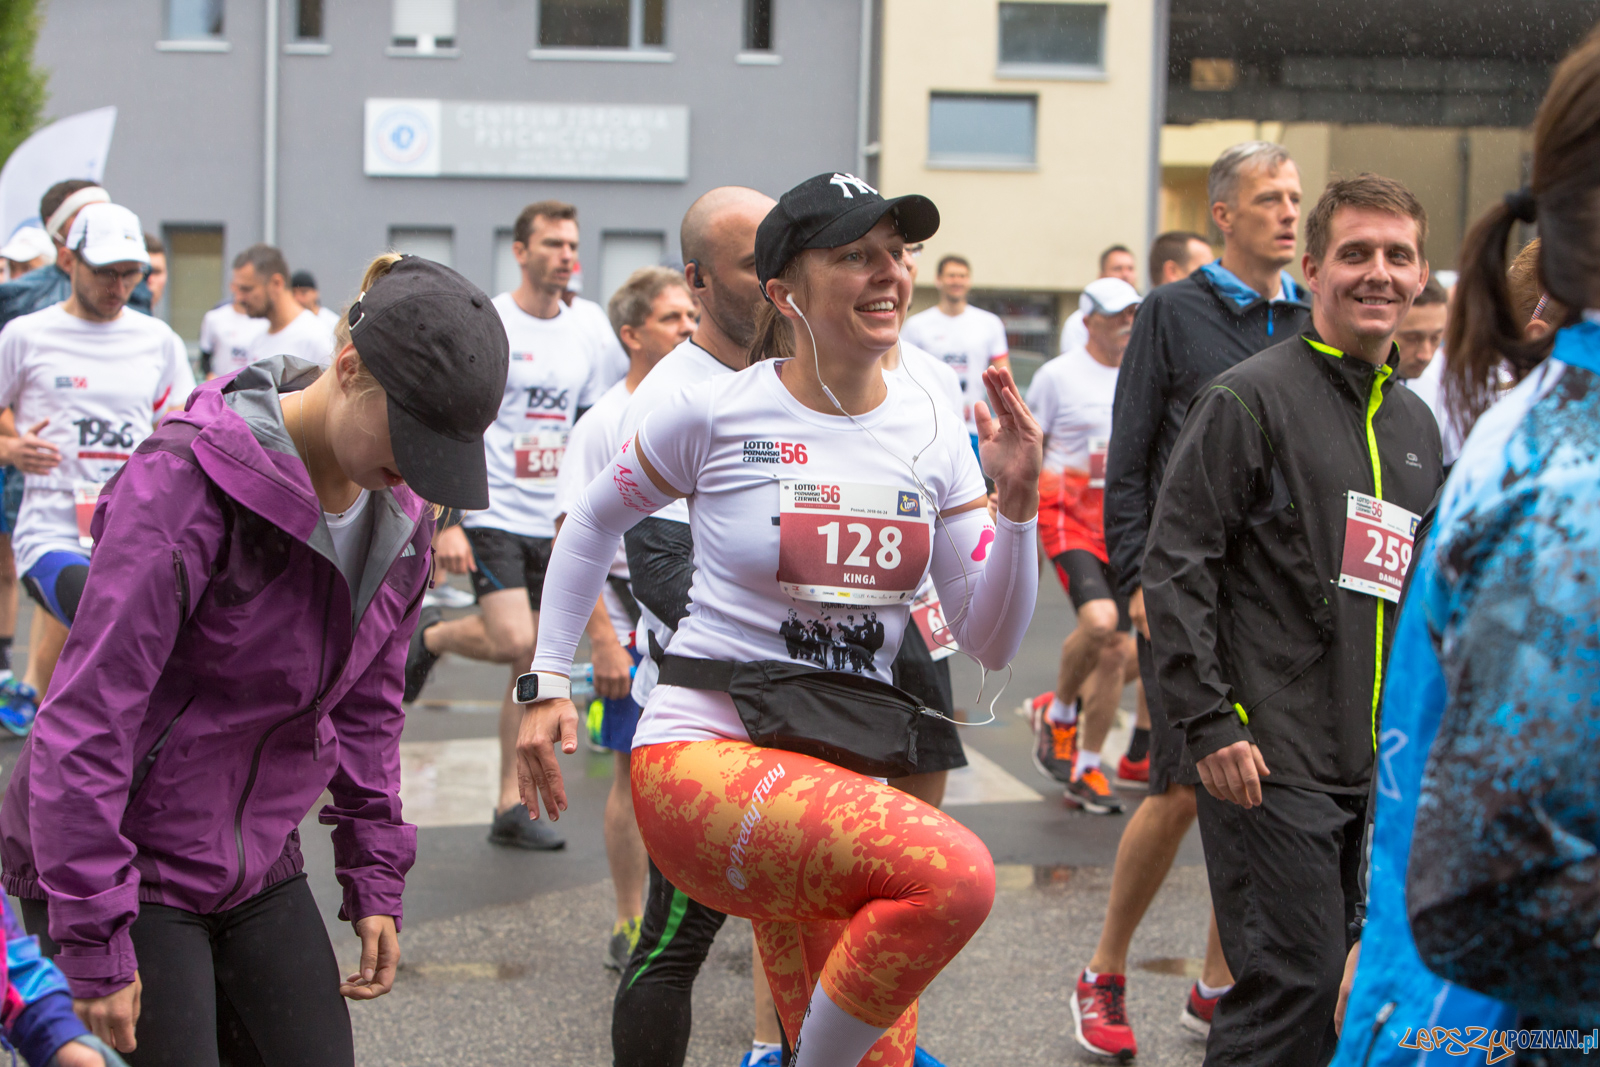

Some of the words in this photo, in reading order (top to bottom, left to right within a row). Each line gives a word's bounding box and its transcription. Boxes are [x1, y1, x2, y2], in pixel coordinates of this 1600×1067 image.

[743, 441, 774, 450] LOTTO
[742, 456, 780, 464] CZERWIEC
[817, 521, 903, 570] 128
[1363, 529, 1412, 576] 259
[843, 572, 876, 585] KINGA
